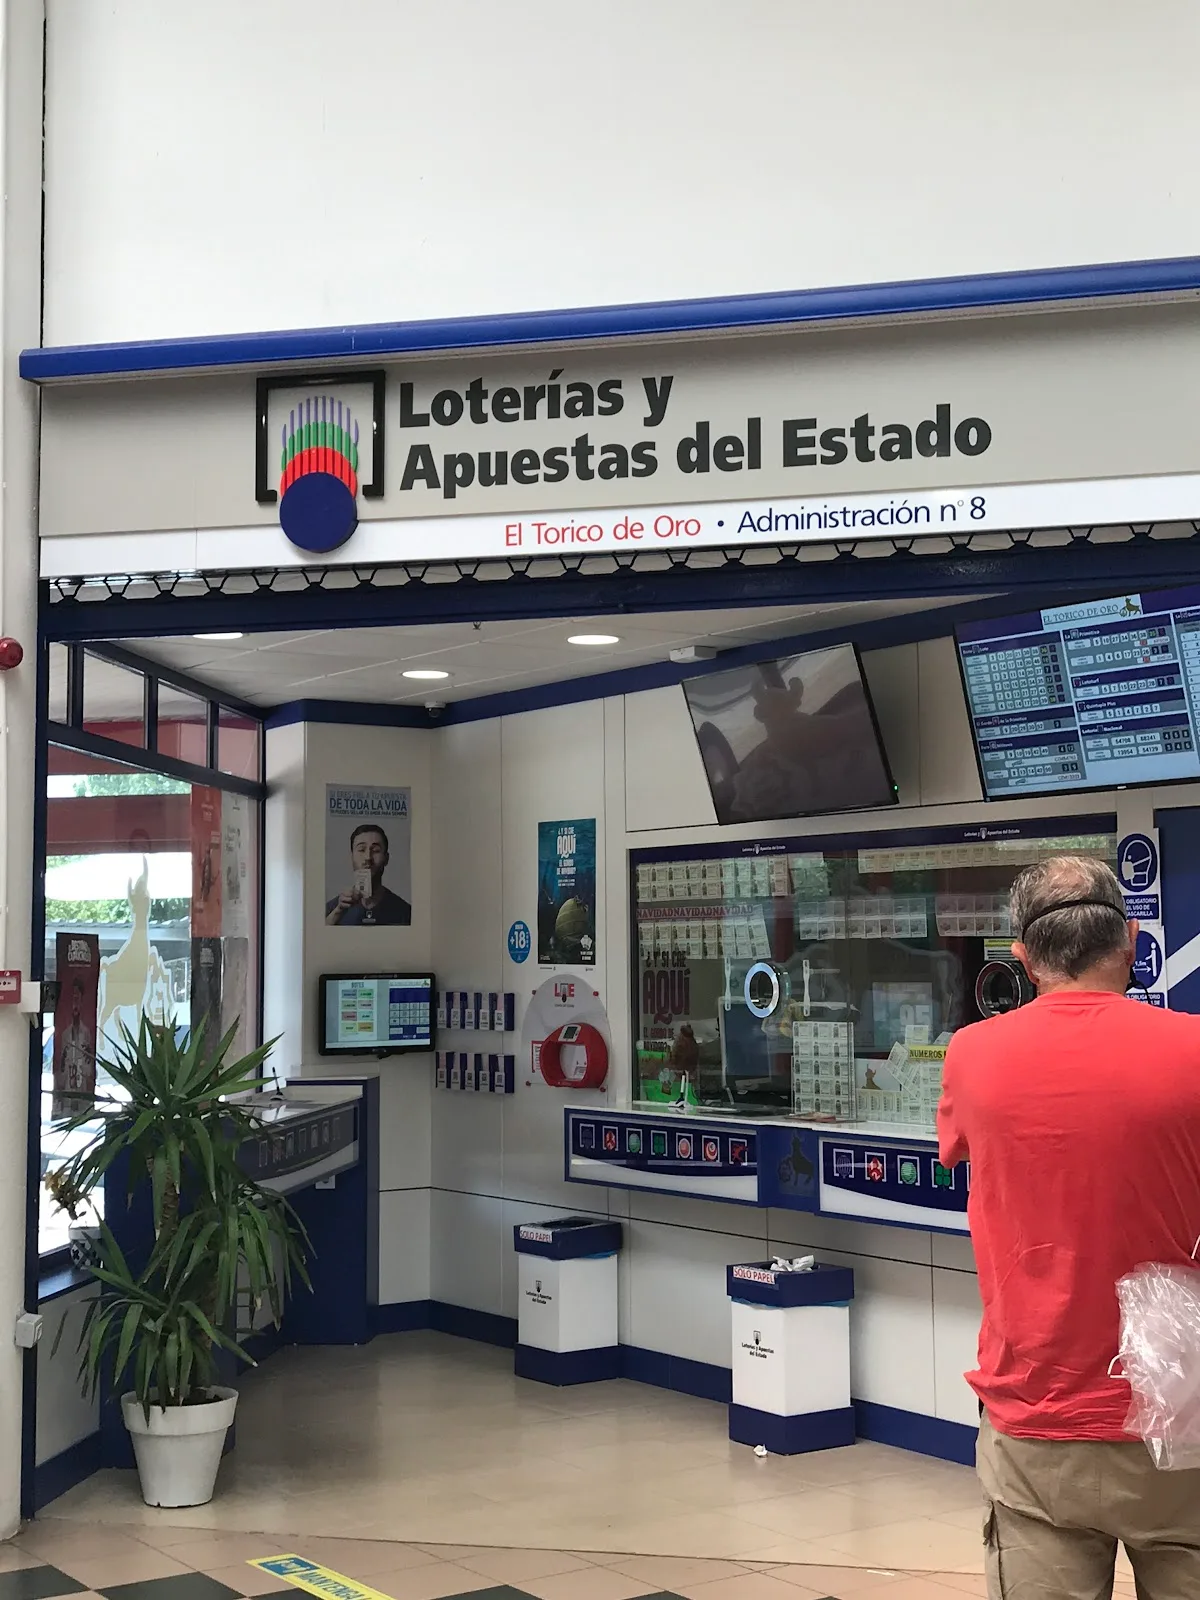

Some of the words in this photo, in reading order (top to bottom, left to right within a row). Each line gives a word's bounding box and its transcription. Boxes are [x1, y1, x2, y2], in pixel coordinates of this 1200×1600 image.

[399, 369, 624, 428] Loterías
[642, 374, 675, 428] y
[400, 432, 659, 499] Apuestas
[676, 416, 762, 475] del
[783, 404, 992, 468] Estado
[505, 521, 523, 547] El
[533, 522, 604, 545] Torico
[613, 517, 644, 541] de
[654, 515, 702, 538] Oro
[737, 498, 930, 534] Administración
[970, 496, 985, 520] 8
[1053, 609, 1085, 622] TORICO
[1100, 603, 1119, 614] ORO
[330, 798, 342, 809] DE
[344, 798, 369, 810] TODA
[371, 799, 383, 811] LA
[385, 800, 407, 811] VIDA
[557, 834, 576, 858] AQUÍ
[510, 931, 526, 949] +18
[643, 968, 690, 1025] AQUÍ
[520, 1230, 534, 1240] SOLO
[535, 1232, 552, 1243] PAPEL
[734, 1268, 752, 1279] SOLO
[753, 1271, 774, 1283] PAPEL
